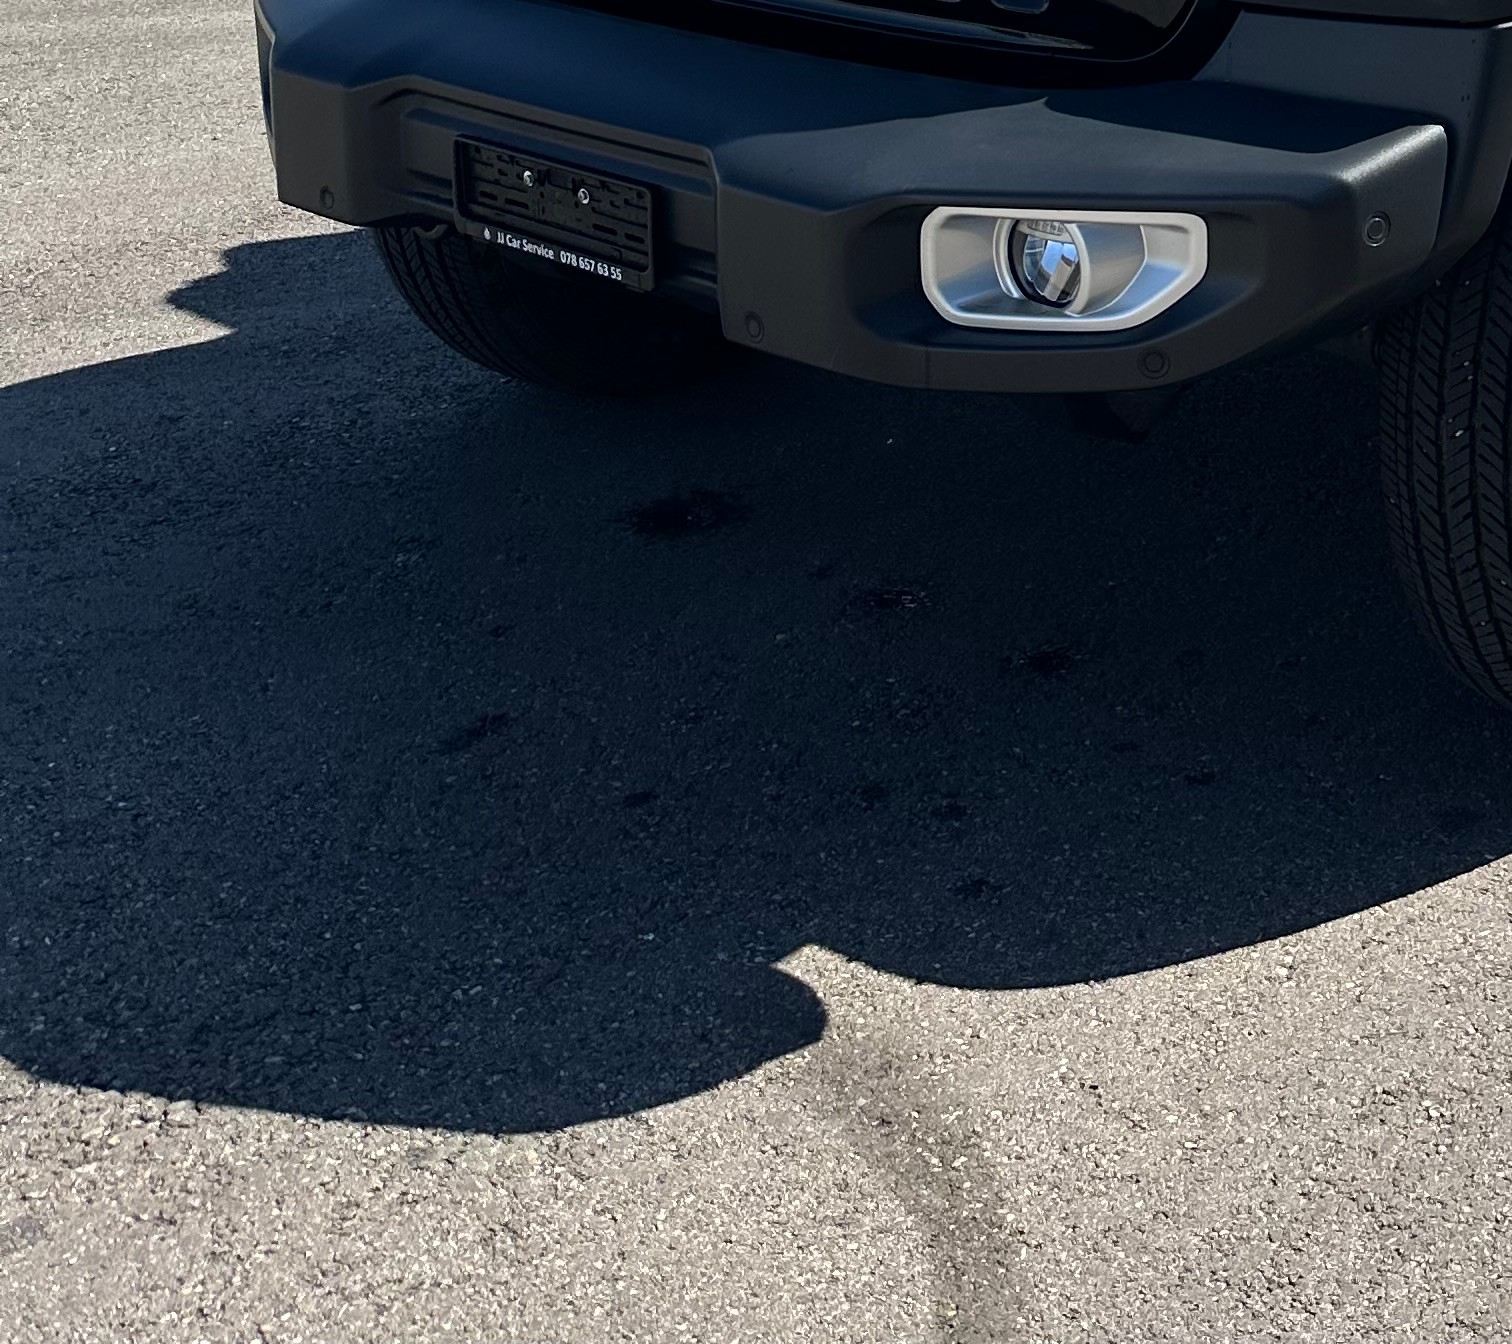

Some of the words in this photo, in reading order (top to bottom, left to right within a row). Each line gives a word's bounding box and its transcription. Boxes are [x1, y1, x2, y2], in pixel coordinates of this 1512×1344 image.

[496, 231, 505, 244] JJ
[506, 234, 522, 249] Car
[522, 238, 555, 260] Service
[560, 250, 578, 267] 078
[578, 256, 596, 273] 657
[597, 262, 609, 277] 63
[610, 266, 623, 281] 55
